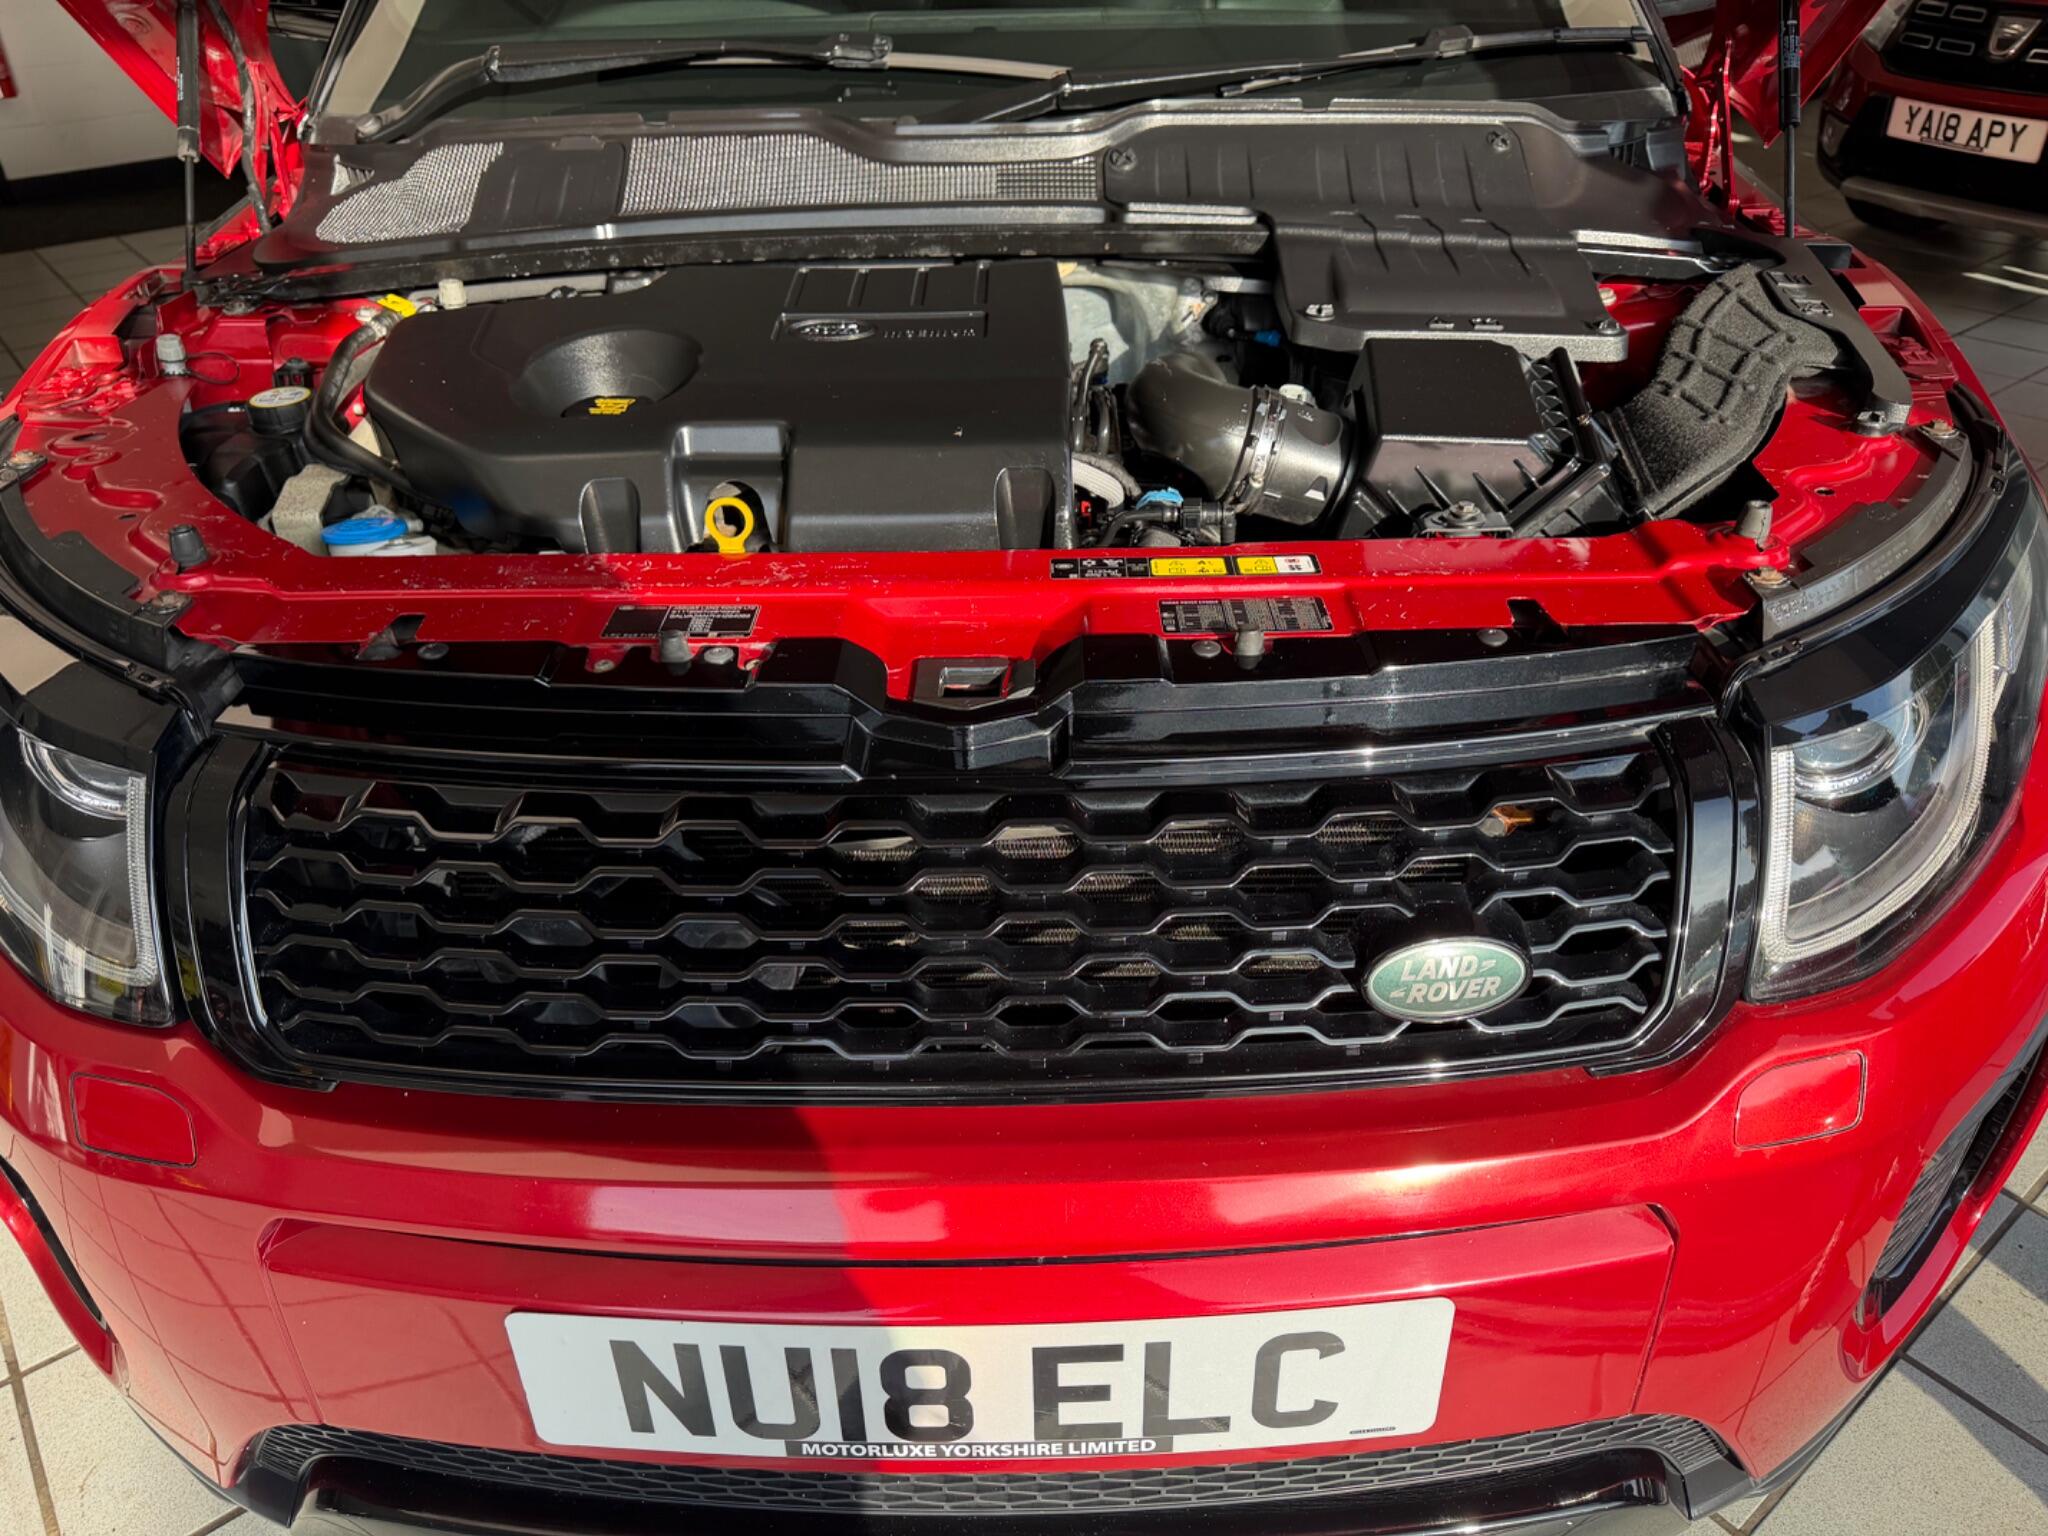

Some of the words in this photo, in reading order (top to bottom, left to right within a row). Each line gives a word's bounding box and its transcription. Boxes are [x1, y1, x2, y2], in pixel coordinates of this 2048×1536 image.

[1905, 105, 1961, 142] YA18
[1966, 118, 2028, 152] APY
[1401, 955, 1478, 981] LAND
[1406, 976, 1501, 1003] ROVER
[609, 1340, 974, 1442] NU18
[1032, 1331, 1346, 1441] ELC
[801, 1443, 936, 1458] MOTORLUXE
[940, 1443, 1063, 1458] YORKSHIRE
[1068, 1438, 1157, 1455] LIMITED
